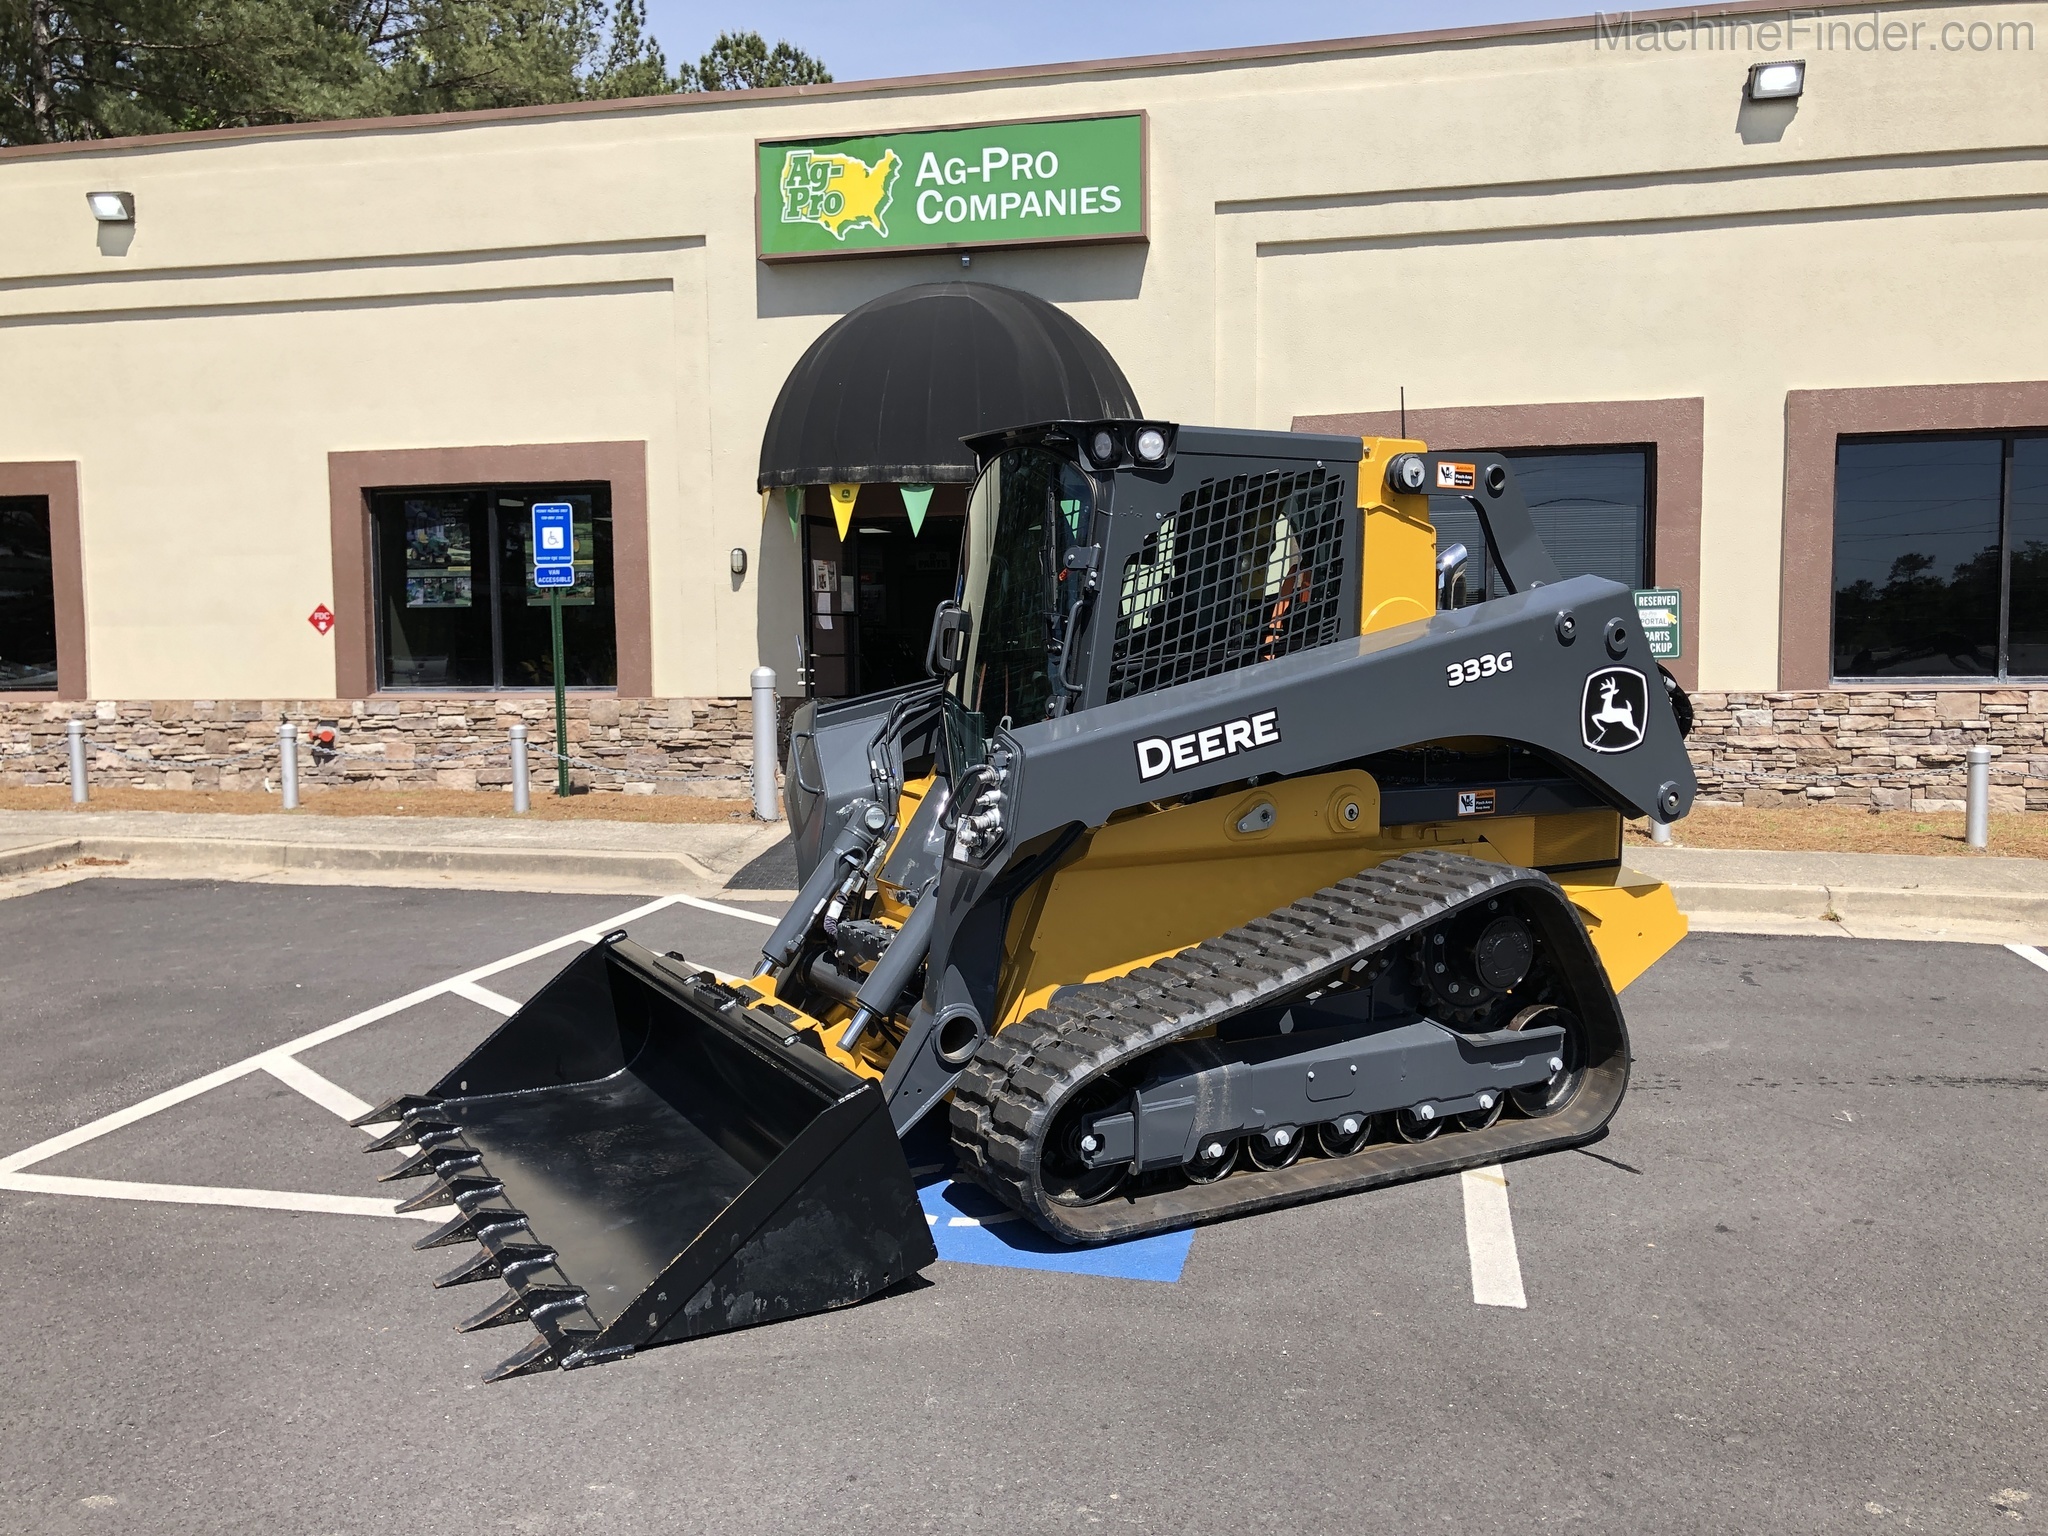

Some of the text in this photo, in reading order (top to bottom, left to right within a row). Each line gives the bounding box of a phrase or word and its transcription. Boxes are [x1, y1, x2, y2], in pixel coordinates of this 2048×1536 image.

[785, 155, 844, 192] Ag-
[785, 187, 844, 219] Pro
[915, 186, 1122, 224] COMPANIES
[1639, 596, 1676, 606] RESERVED
[1650, 642, 1673, 653] CKUP
[1446, 651, 1514, 687] 333G
[1136, 710, 1280, 780] DEERE
